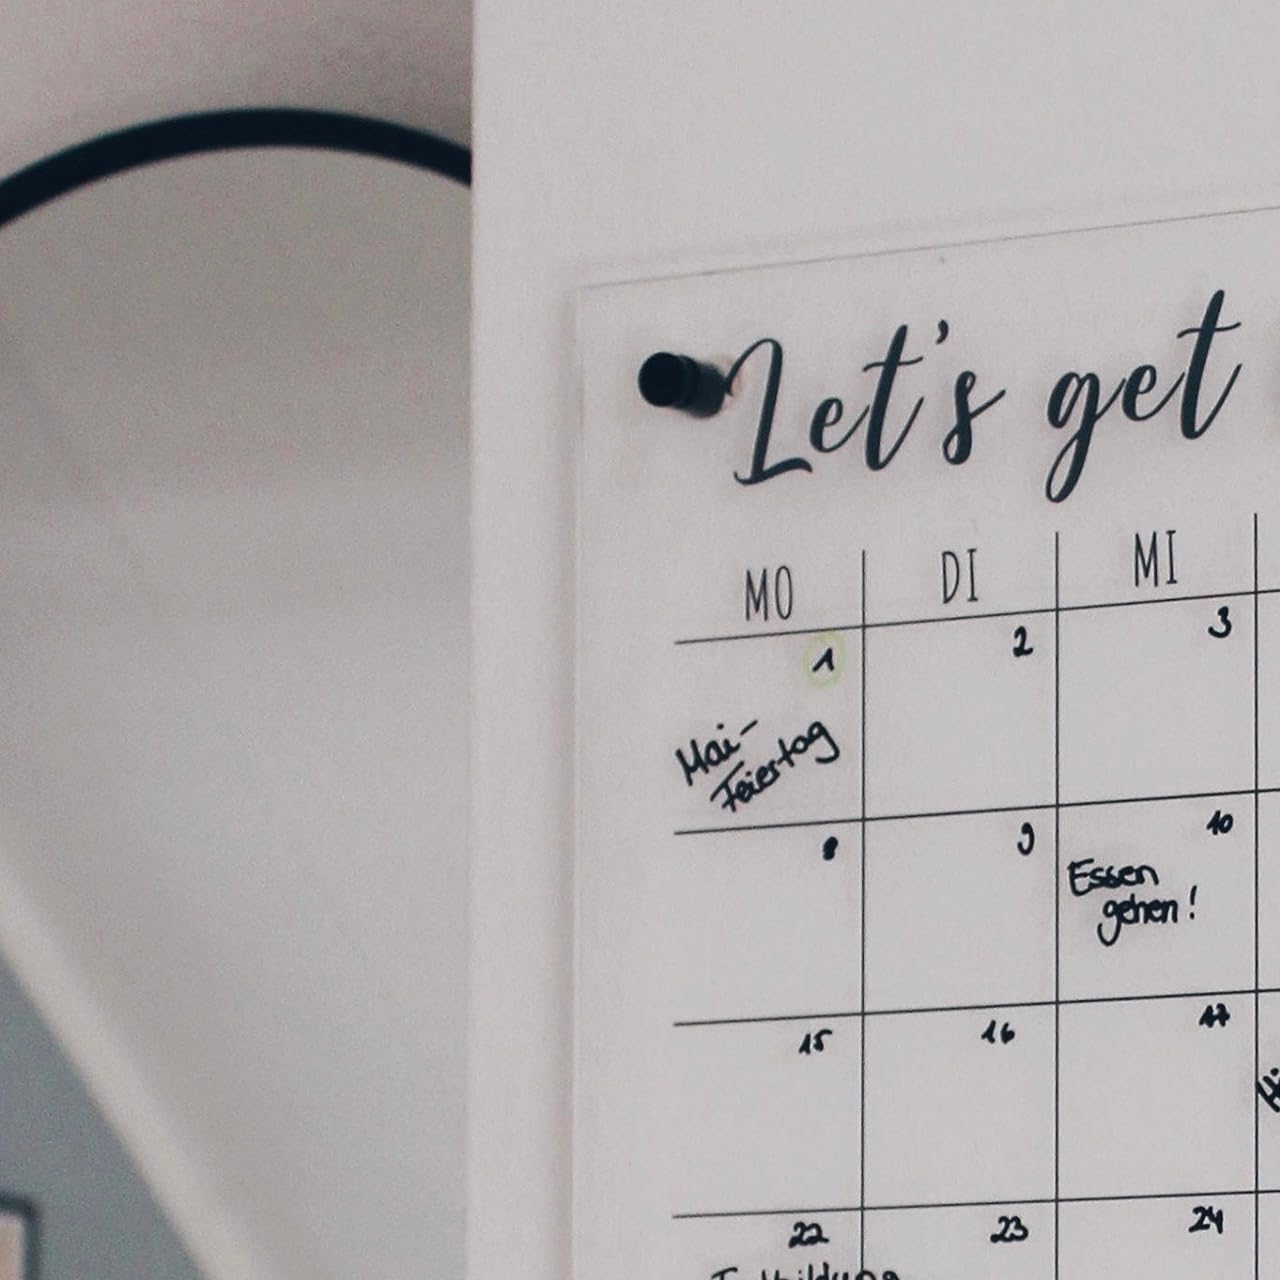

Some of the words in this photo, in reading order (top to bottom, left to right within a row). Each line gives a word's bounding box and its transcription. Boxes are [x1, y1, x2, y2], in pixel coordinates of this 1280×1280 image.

[726, 319, 1007, 486] Let's
[1045, 289, 1241, 503] get
[1134, 529, 1178, 588] MI
[941, 547, 979, 605] DI
[745, 565, 793, 622] MO
[1207, 605, 1233, 639] 3
[1012, 625, 1034, 658] 2
[811, 647, 835, 673] 1
[676, 719, 759, 787] Mai-
[710, 720, 841, 813] Feiertag
[1016, 821, 1036, 857] 9
[1205, 809, 1234, 836] 10
[1066, 857, 1160, 897] Essen
[980, 1019, 1016, 1045] 16
[1198, 1002, 1231, 1029] 17
[798, 1028, 833, 1056] 15
[787, 1220, 830, 1249] 22
[989, 1215, 1030, 1244] 23
[1187, 1205, 1224, 1235] 24
